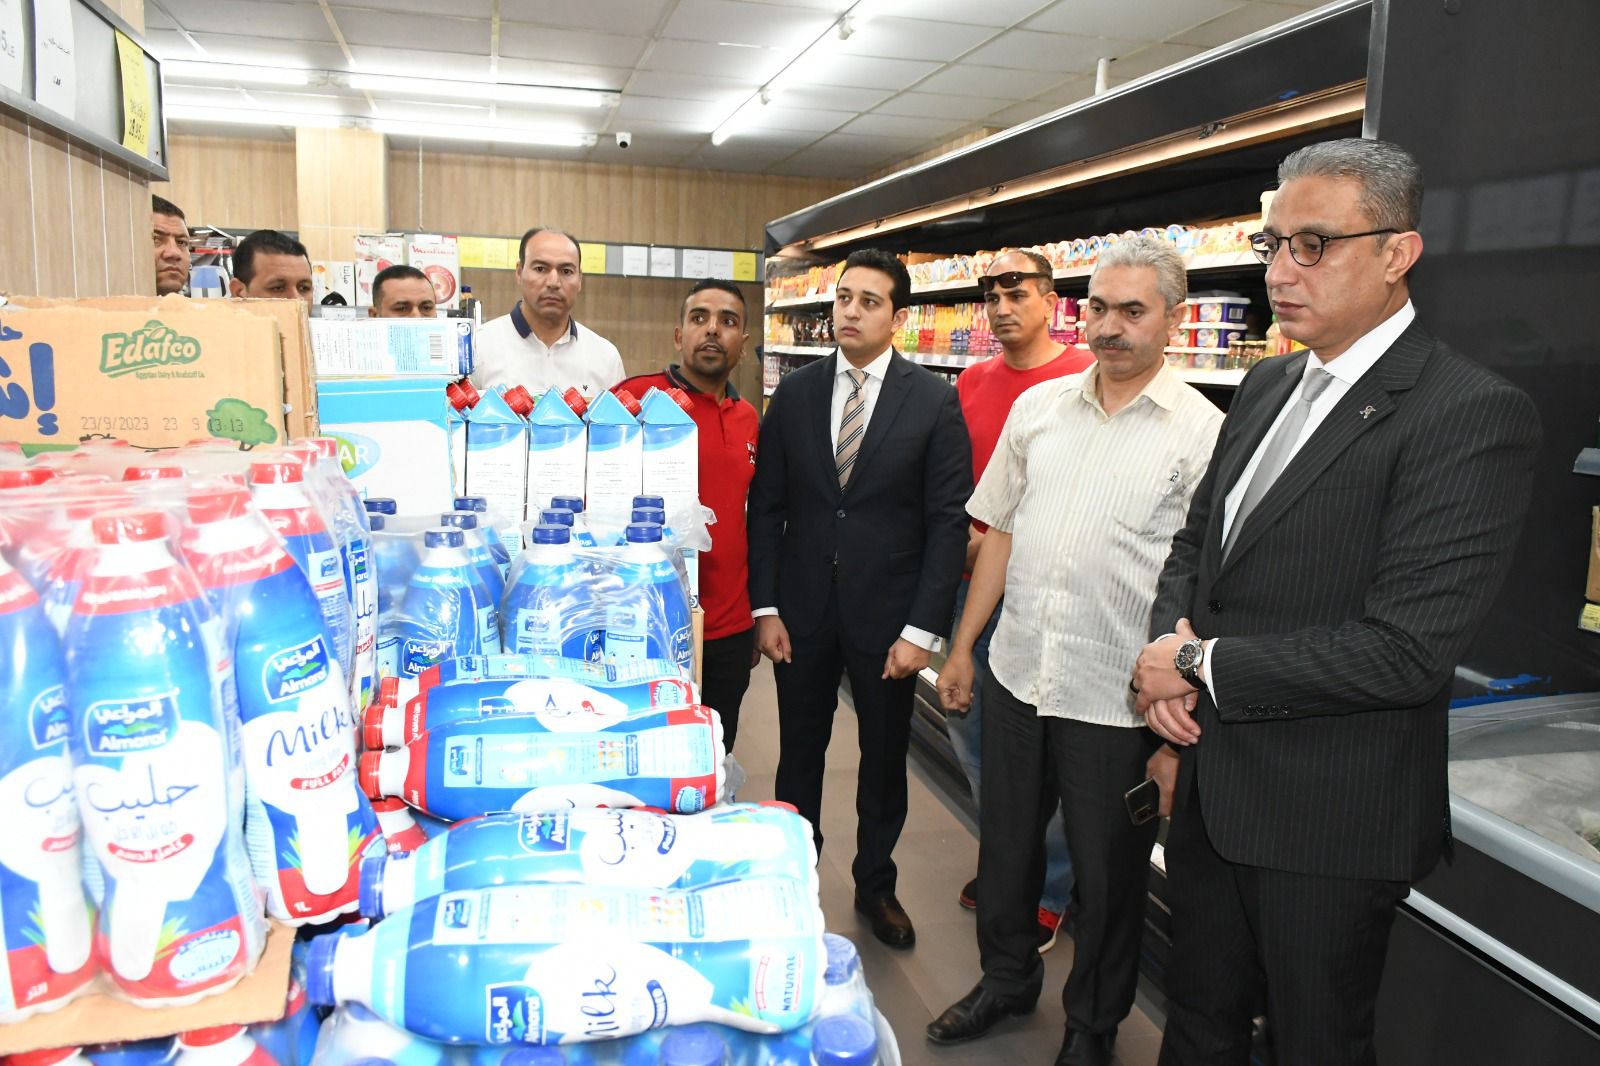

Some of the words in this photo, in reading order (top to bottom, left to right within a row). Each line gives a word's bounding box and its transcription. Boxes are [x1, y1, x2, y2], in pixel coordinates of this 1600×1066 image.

[105, 336, 197, 369] Edafco
[81, 416, 149, 431] 23/9/2023
[163, 417, 178, 431] 23
[193, 417, 200, 431] 9
[340, 445, 370, 473] AR
[271, 641, 321, 673] المراعي
[279, 666, 327, 697] Almarai
[94, 700, 163, 724] المراعي
[99, 728, 168, 751] Almarai
[267, 706, 348, 767] Milk
[301, 775, 331, 790] FULL
[331, 761, 348, 779] FAT
[86, 763, 199, 820] حليب
[294, 901, 312, 913] 1L
[782, 955, 796, 1012] NATURAL
